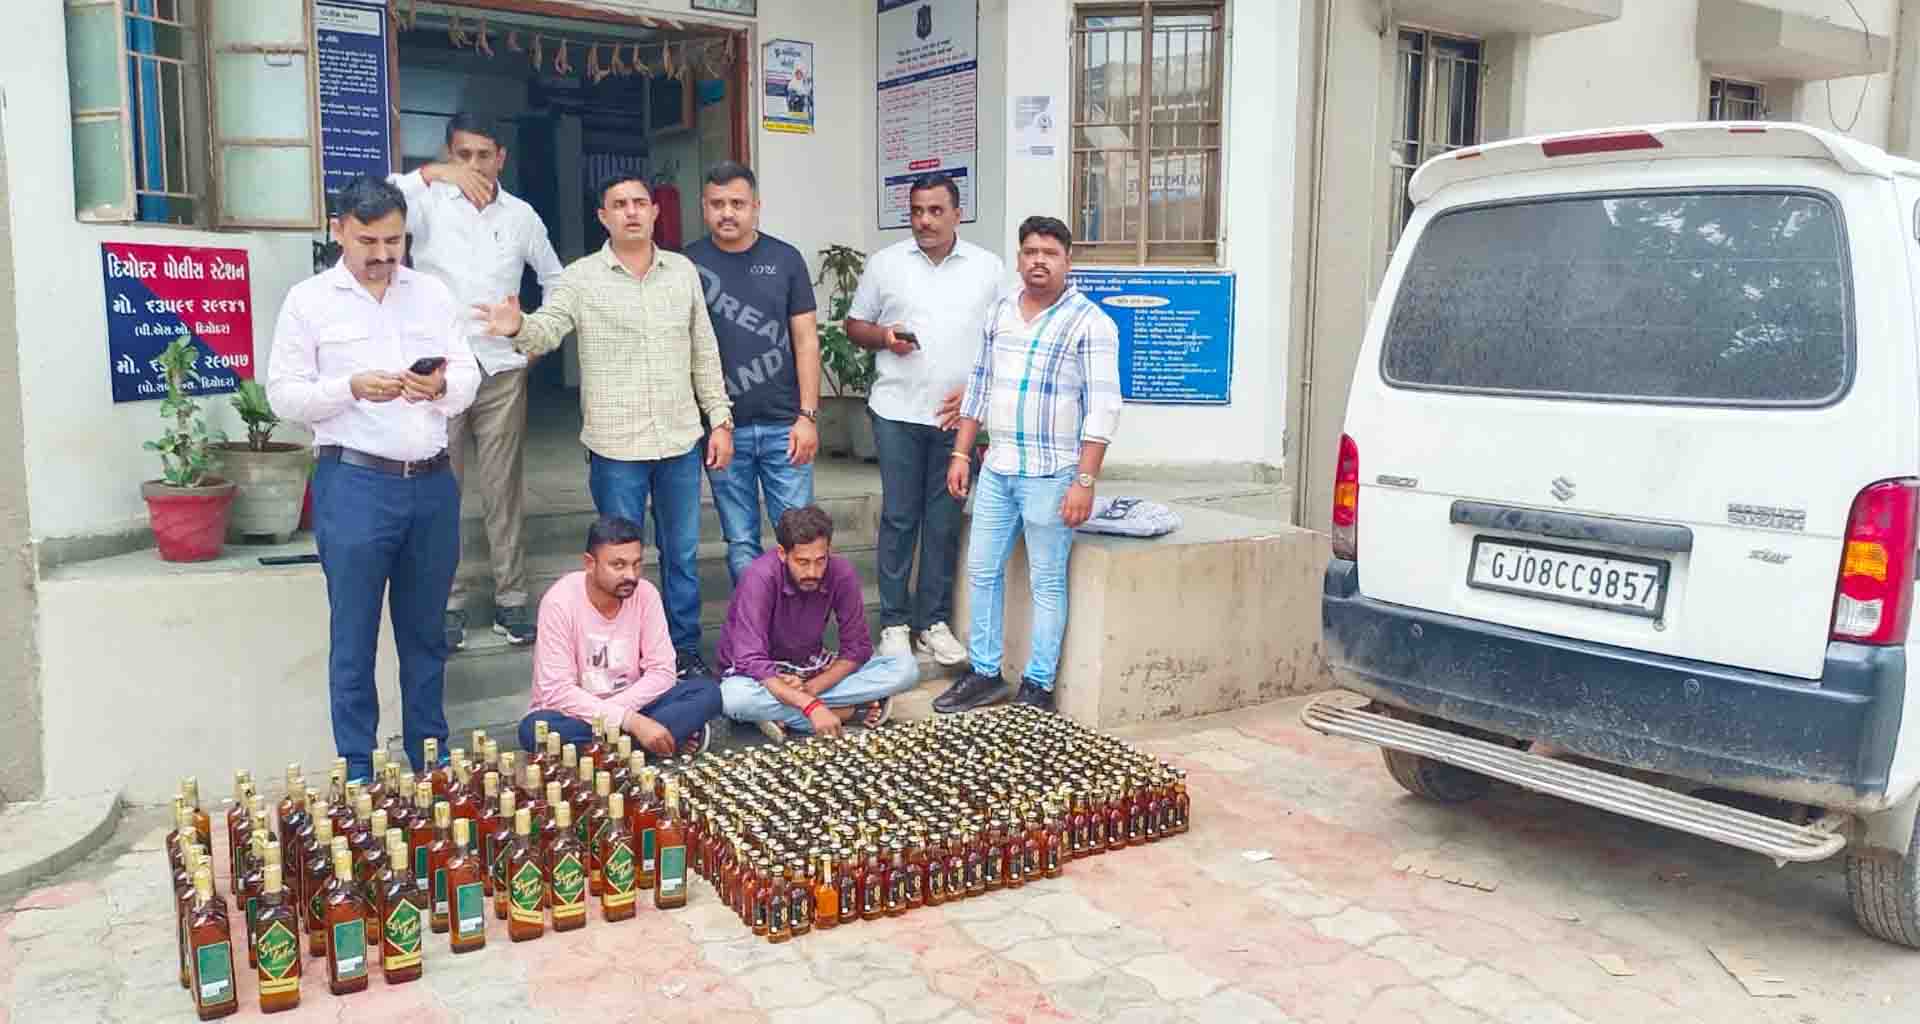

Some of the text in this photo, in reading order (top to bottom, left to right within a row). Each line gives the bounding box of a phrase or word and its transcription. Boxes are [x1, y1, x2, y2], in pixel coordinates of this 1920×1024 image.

[107, 253, 245, 281] દિયોદર પોલીસ સ્ટેશન
[112, 294, 136, 314] મો.
[116, 354, 140, 374] મો.
[1491, 552, 1657, 604] GJ08CC9857
